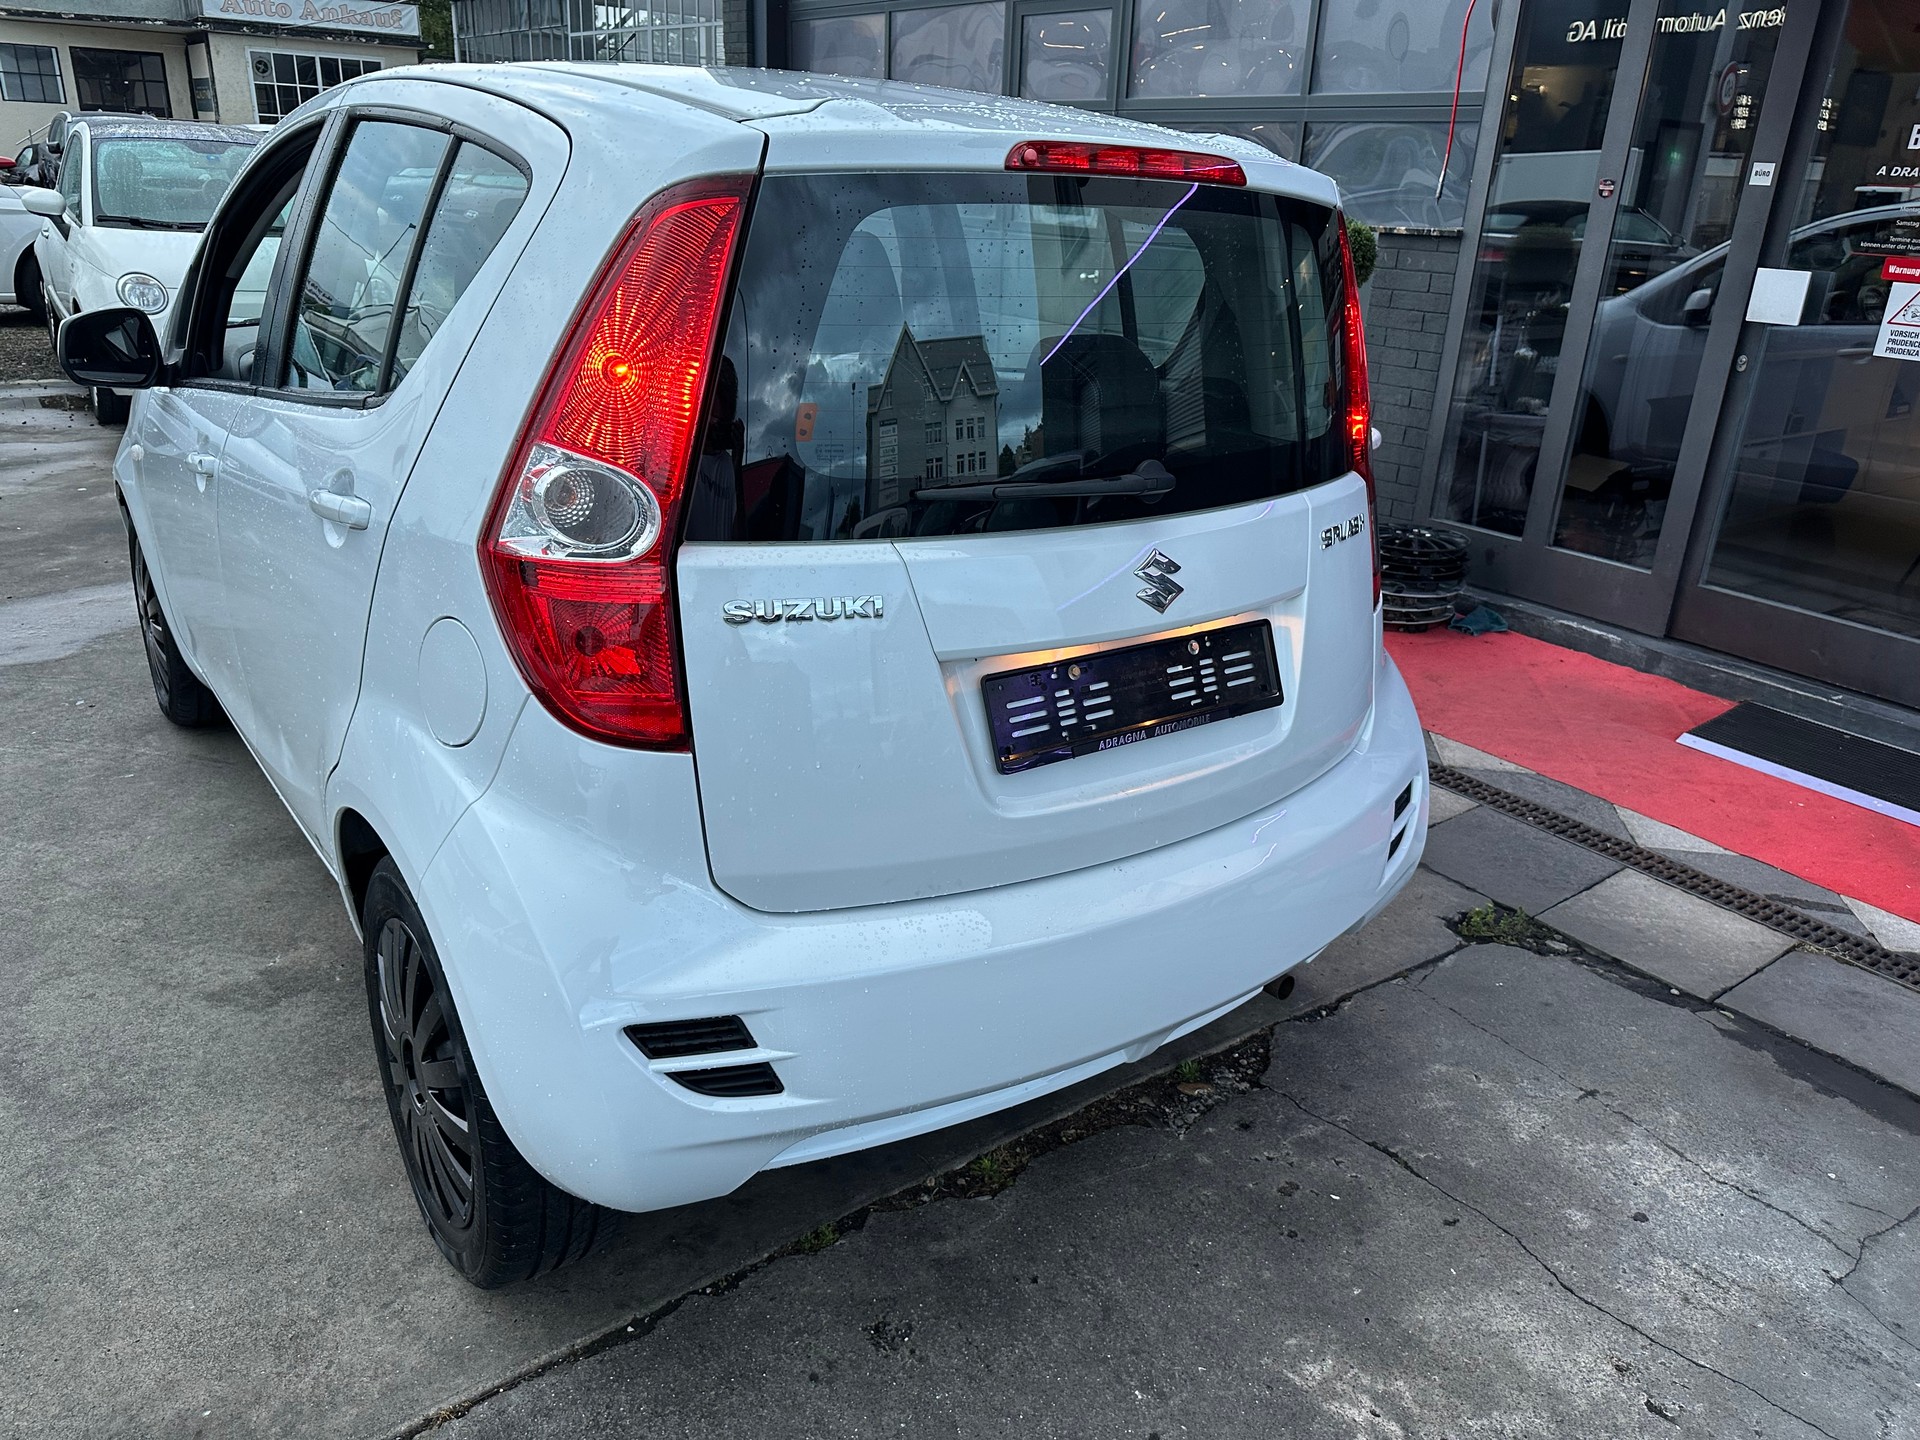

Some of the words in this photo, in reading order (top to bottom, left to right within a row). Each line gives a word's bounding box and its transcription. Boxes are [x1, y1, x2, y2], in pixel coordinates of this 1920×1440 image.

[221, 0, 293, 18] Auto
[299, 0, 403, 29] Ankauf
[1754, 168, 1771, 178] BÜRO
[1890, 166, 1920, 177] DRA
[1896, 220, 1920, 228] Samstag
[1889, 235, 1911, 243] Termine
[1885, 346, 1920, 357] PRUDENZA
[1320, 513, 1364, 550] SPLASH
[723, 595, 883, 625] SUZUKI
[1098, 729, 1147, 751] ADRAGNA
[1154, 714, 1211, 737] AUTOMOBILE
